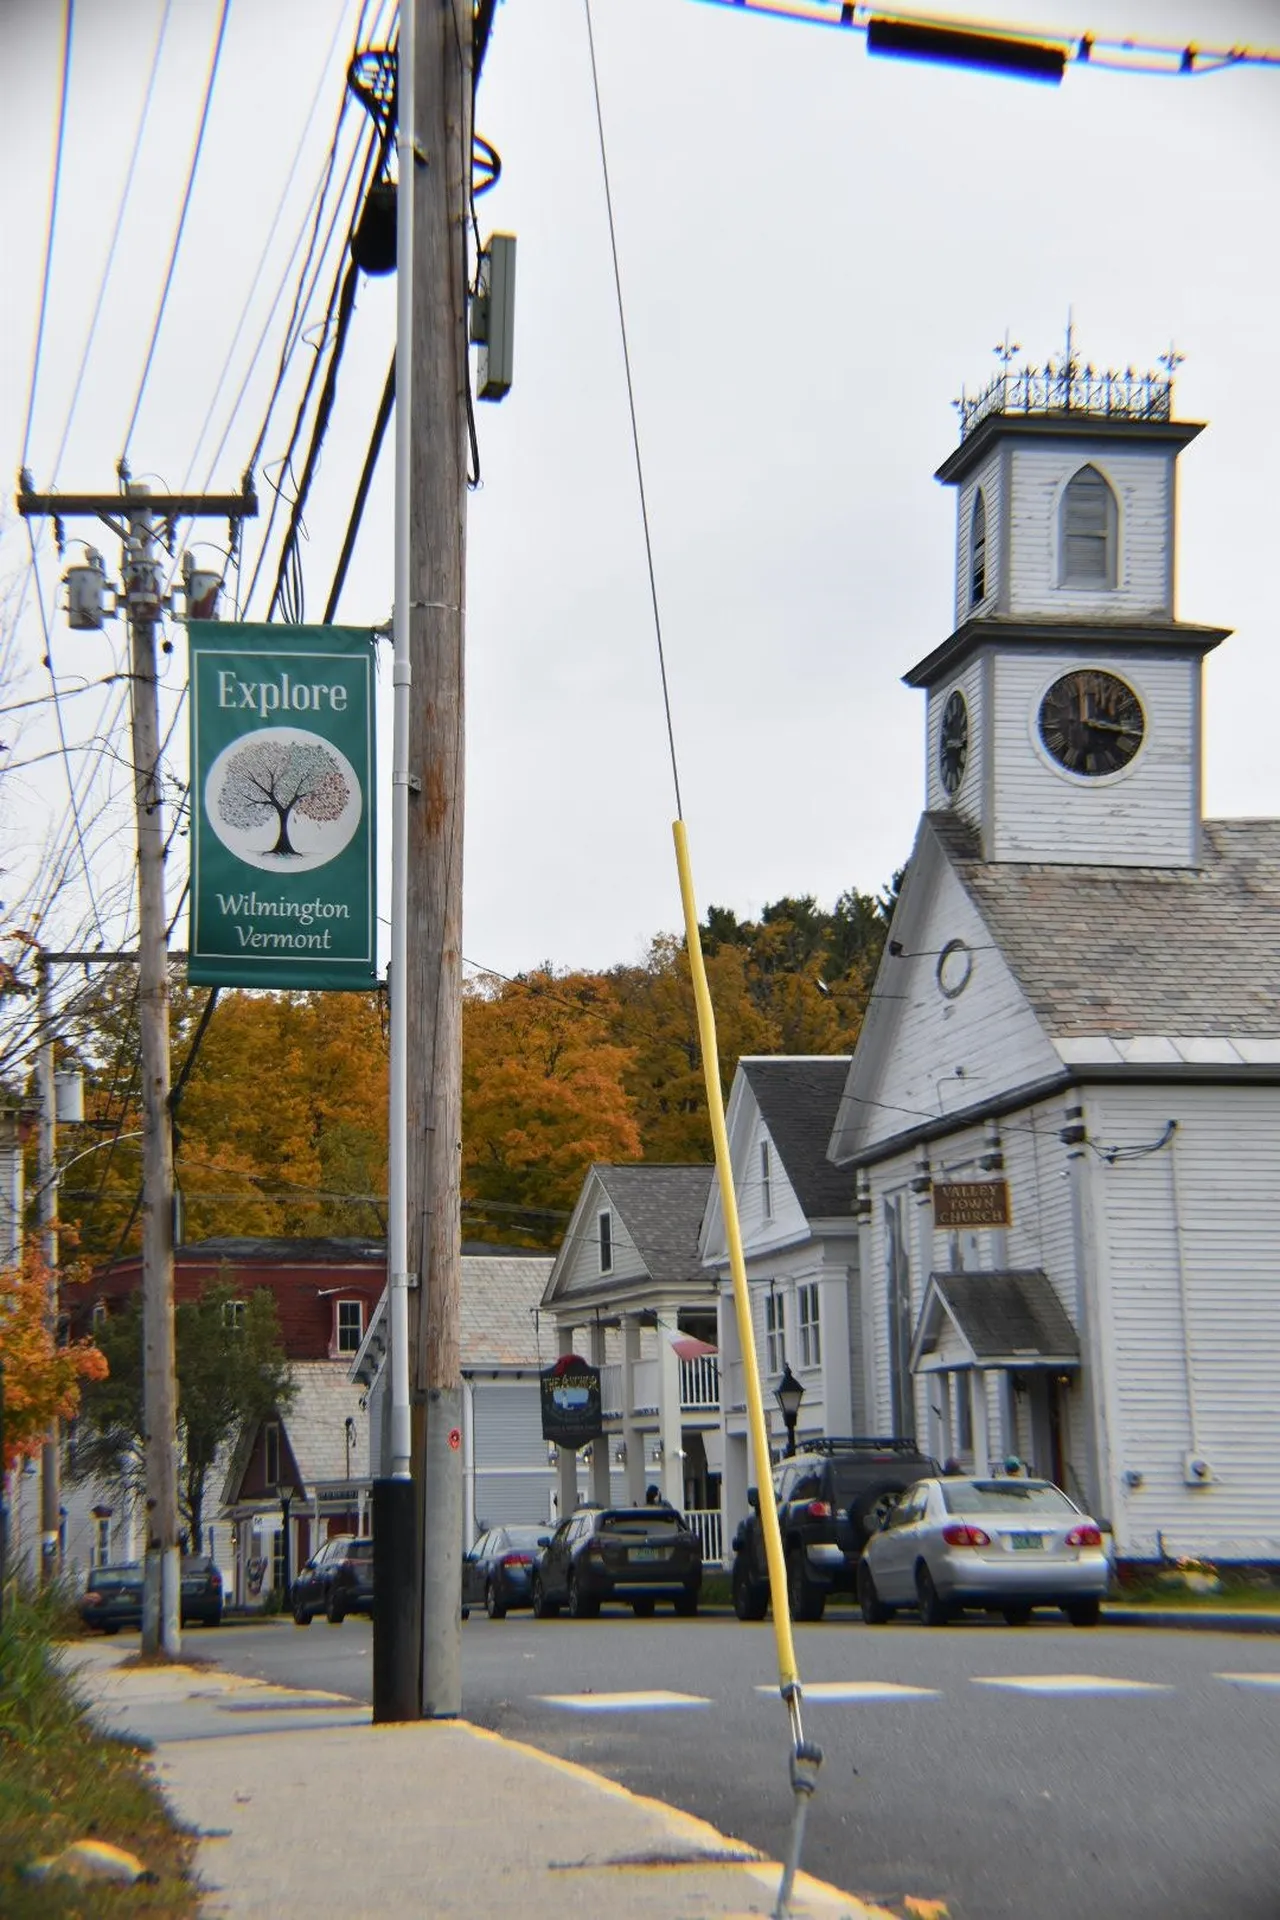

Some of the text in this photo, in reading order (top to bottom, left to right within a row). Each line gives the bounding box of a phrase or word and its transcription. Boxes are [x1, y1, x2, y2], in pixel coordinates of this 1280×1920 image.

[217, 669, 348, 718] Explore
[215, 891, 351, 926] Wilmington
[234, 925, 332, 949] Vermont
[942, 1184, 997, 1197] VALLEY
[949, 1198, 994, 1210] TOWN
[940, 1210, 1003, 1223] CHURCH
